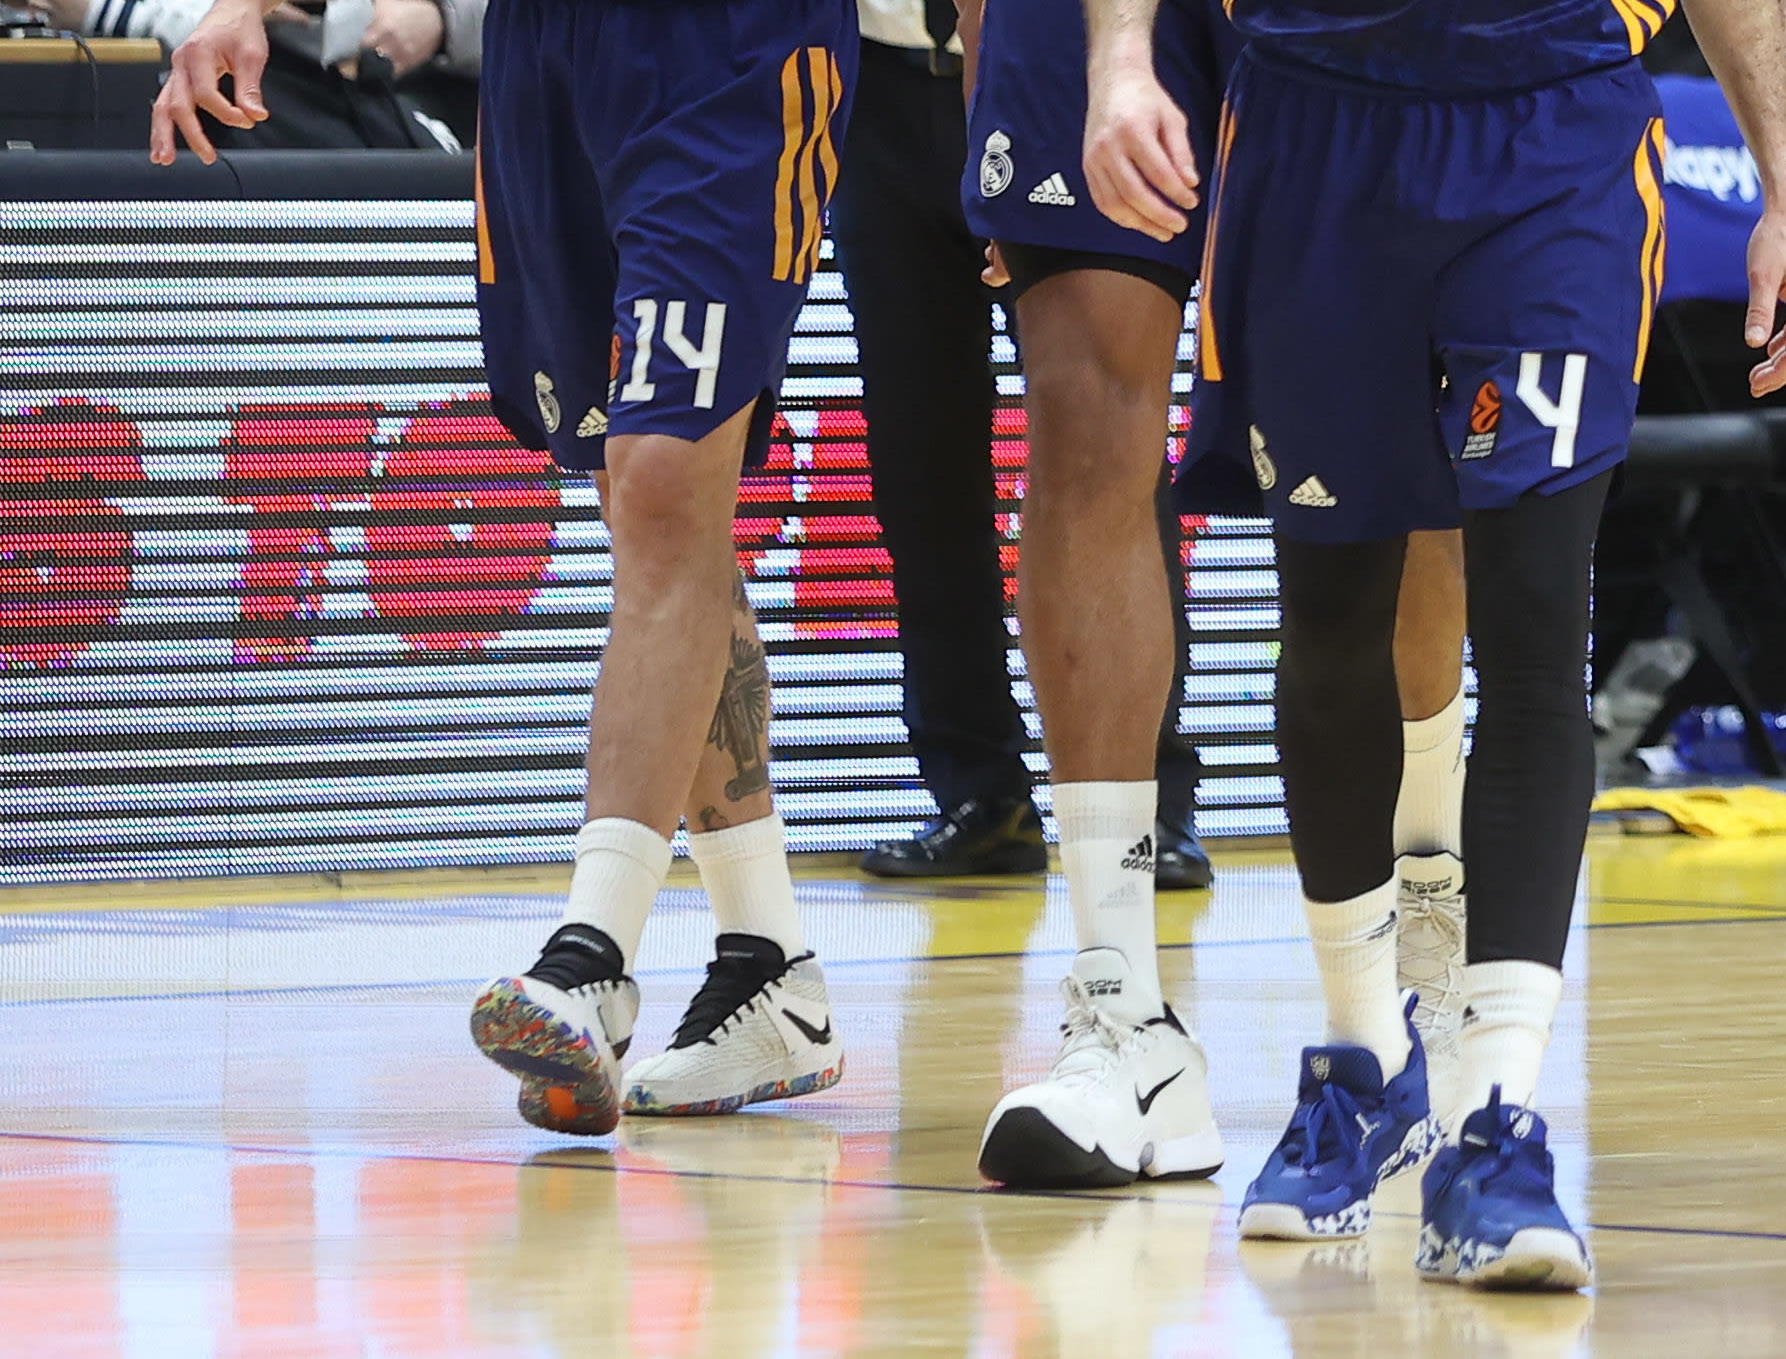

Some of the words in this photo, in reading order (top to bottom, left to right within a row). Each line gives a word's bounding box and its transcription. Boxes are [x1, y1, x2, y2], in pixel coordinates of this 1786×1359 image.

[1028, 192, 1076, 206] adidas
[620, 298, 728, 410] 14
[1516, 351, 1588, 468] 4
